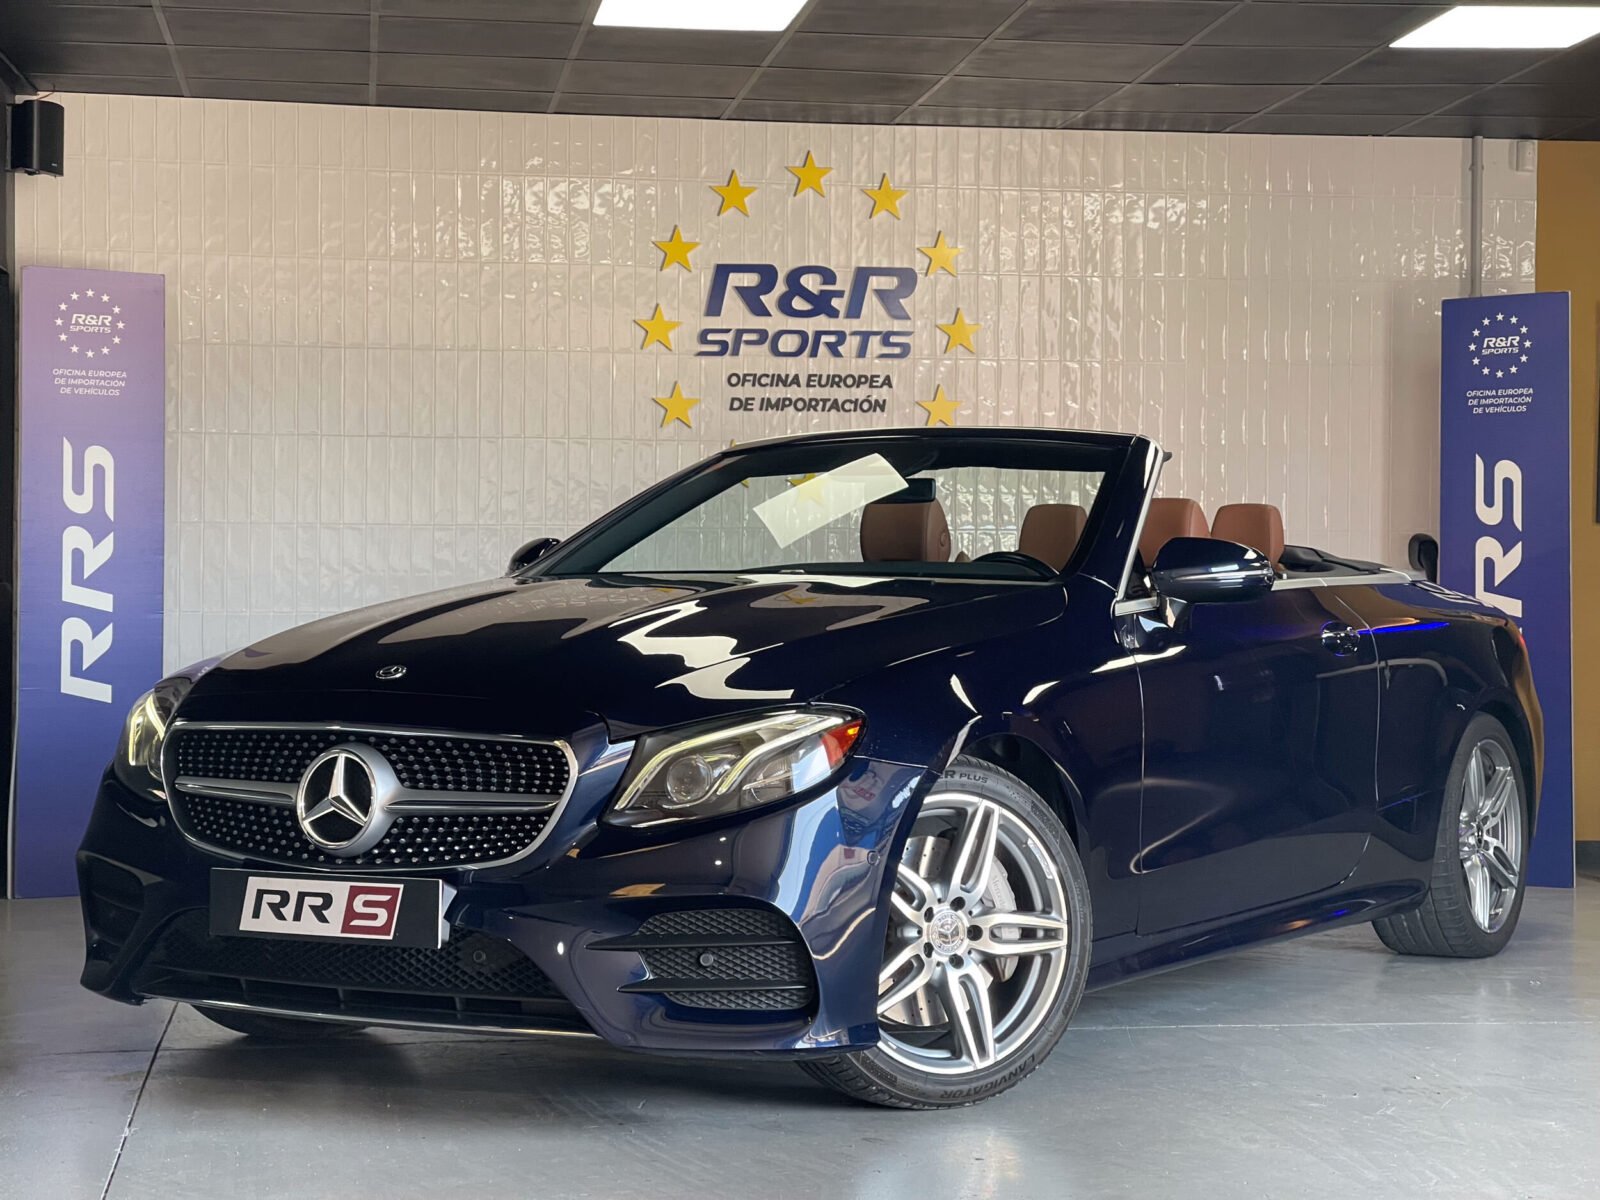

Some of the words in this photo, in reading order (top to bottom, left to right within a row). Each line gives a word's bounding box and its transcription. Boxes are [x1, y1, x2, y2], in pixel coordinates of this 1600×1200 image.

[704, 264, 918, 320] R&R
[71, 313, 112, 326] R&R
[69, 325, 111, 334] SPORTS
[694, 328, 914, 359] SPORTS
[1483, 336, 1520, 348] R&R
[1481, 347, 1519, 355] SPORTS
[52, 368, 86, 377] OFICINA
[88, 369, 127, 378] EUROPEA
[54, 377, 67, 385] DE
[727, 373, 801, 388] OFICINA
[806, 374, 893, 389] EUROPEA
[60, 387, 72, 395] DE
[74, 387, 120, 396] VEHÍCULOS
[1466, 389, 1497, 397] OFICINA
[1498, 387, 1534, 396] EUROPEA
[729, 397, 755, 412] DE
[759, 395, 887, 413] IMPORTACIÓN
[1480, 396, 1532, 405] IMPORTACIÓN
[1485, 405, 1527, 414] VEHÍCULOS
[1475, 453, 1522, 618] RS
[61, 437, 114, 703] RRS
[960, 772, 989, 784] PLUS
[251, 888, 392, 927] RRS
